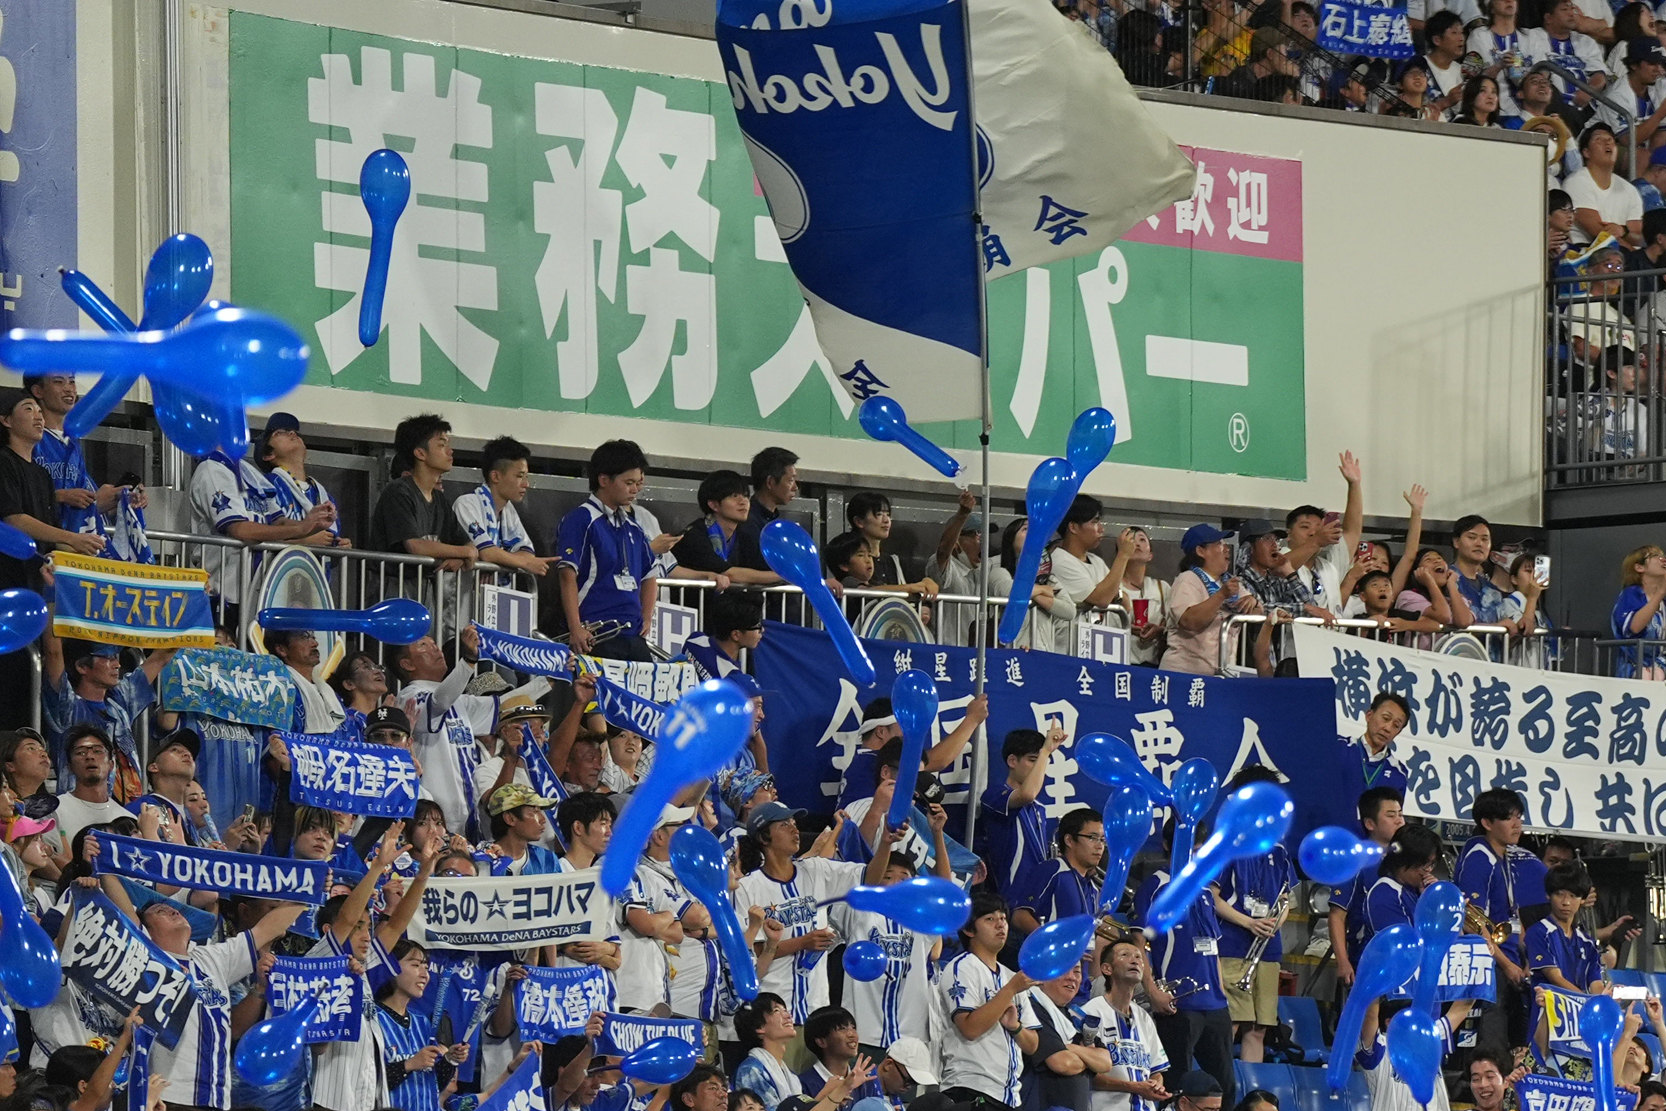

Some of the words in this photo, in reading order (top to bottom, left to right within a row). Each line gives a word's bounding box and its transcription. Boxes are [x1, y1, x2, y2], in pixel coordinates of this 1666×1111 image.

[1145, 160, 1269, 245] 歓迎
[80, 580, 188, 628] T.オースティン
[177, 657, 294, 706] 山本祐大
[1076, 666, 1206, 709] 全国制覇
[291, 743, 416, 800] 蝦名達夫
[111, 852, 118, 868] I
[157, 852, 314, 895] YOKOHAMA
[423, 886, 479, 926] 我らの
[512, 881, 597, 921] ヨコハマ
[436, 930, 497, 945] YOKOHAMA
[500, 928, 528, 942] DeNA
[531, 923, 582, 940] BAYSTARS
[463, 988, 480, 1001] 72
